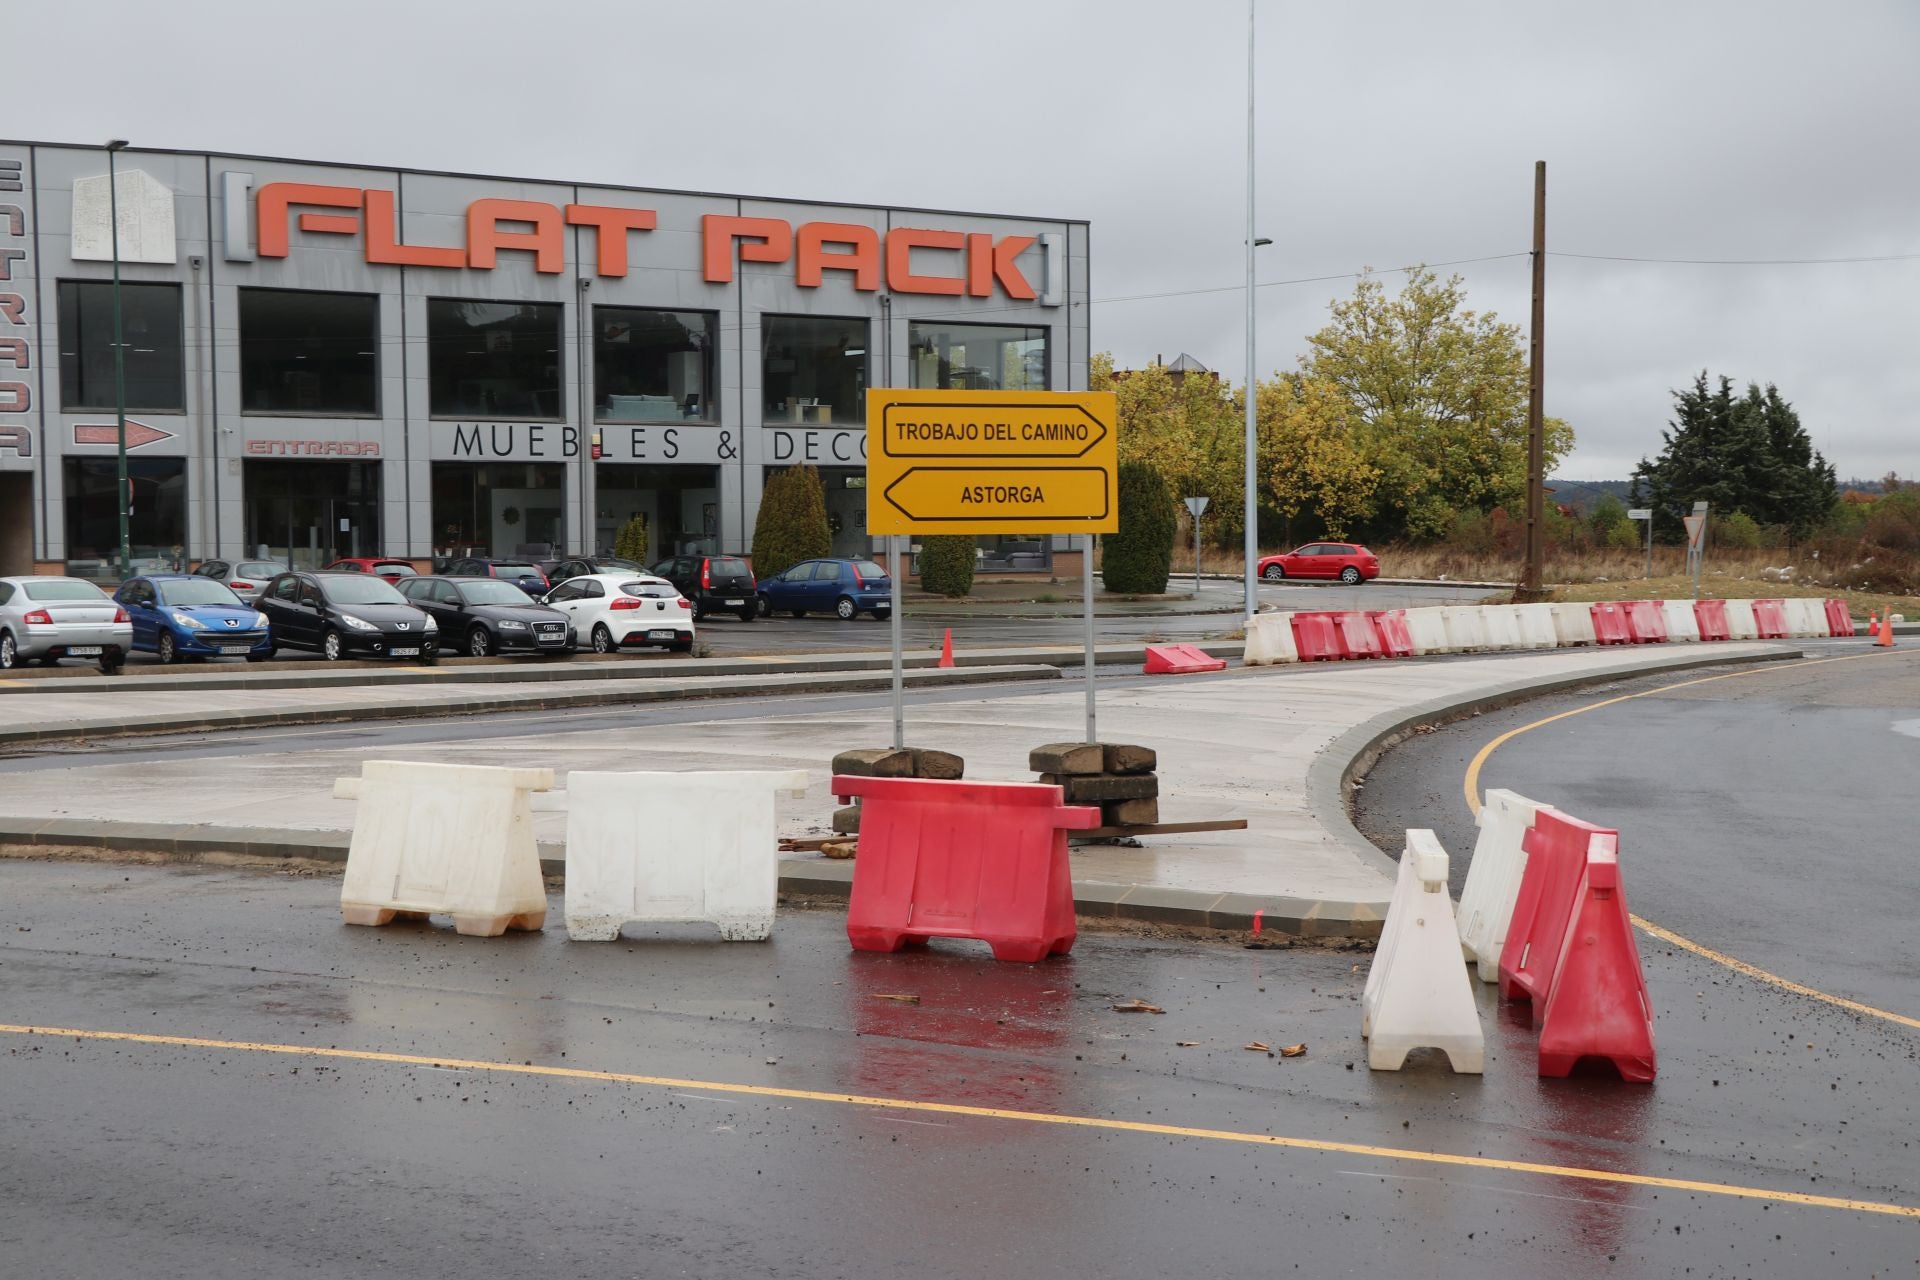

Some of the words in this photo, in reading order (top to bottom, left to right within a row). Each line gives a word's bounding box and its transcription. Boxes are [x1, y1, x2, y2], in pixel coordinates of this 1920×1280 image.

[896, 422, 979, 441] TROBAJO
[984, 423, 1017, 441] DEL
[1021, 423, 1089, 441] CAMINO
[247, 439, 380, 456] ENTRADA
[452, 423, 679, 459] MUEBLES
[717, 430, 738, 460] &
[774, 431, 867, 462] DEC
[960, 486, 1045, 503] ASTORGA
